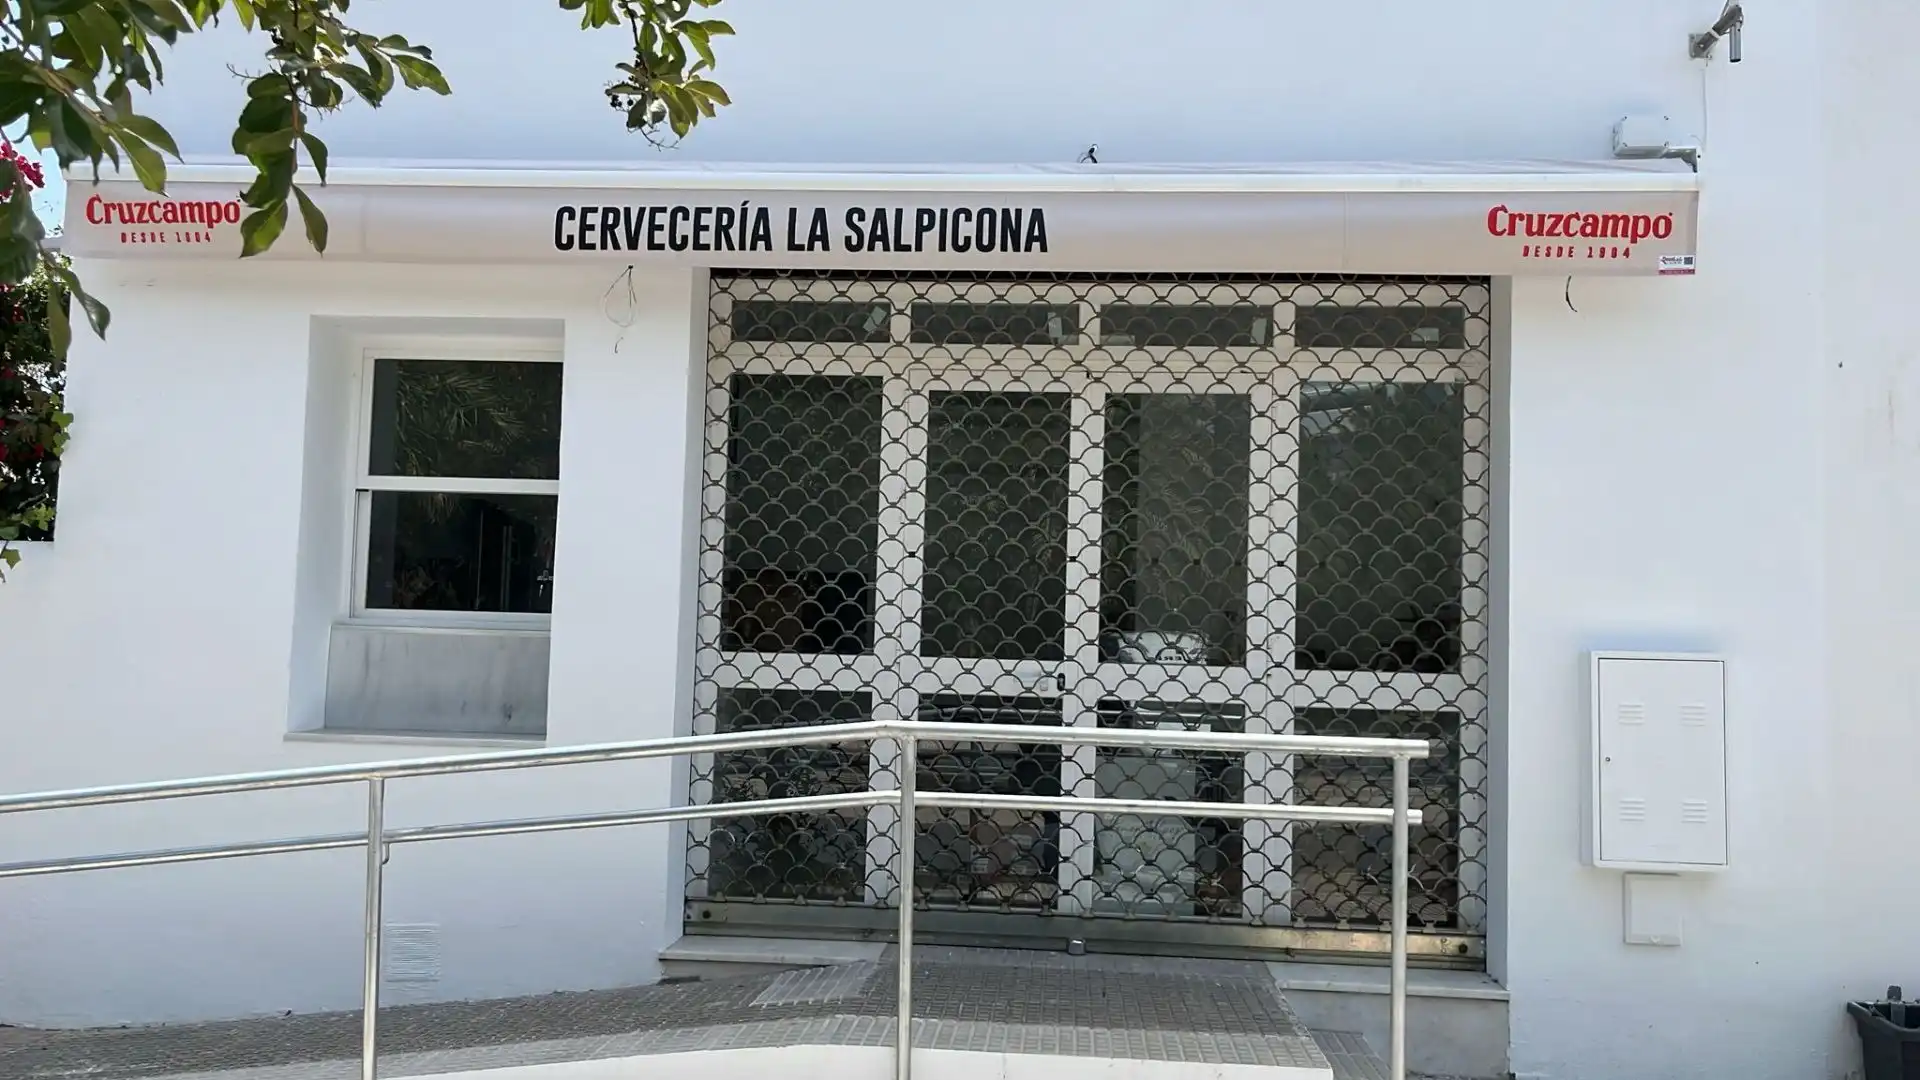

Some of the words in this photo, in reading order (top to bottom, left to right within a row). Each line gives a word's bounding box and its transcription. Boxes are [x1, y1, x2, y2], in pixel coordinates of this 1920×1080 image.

[86, 194, 241, 228] Cruzcampo
[554, 201, 773, 252] CERVECERÍA
[787, 207, 831, 252] LA
[844, 207, 1049, 253] SALPICONA
[1487, 204, 1673, 244] Cruzcampo
[121, 232, 166, 243] DESDE
[1522, 246, 1575, 258] DESDE
[1587, 246, 1631, 259] 1904
